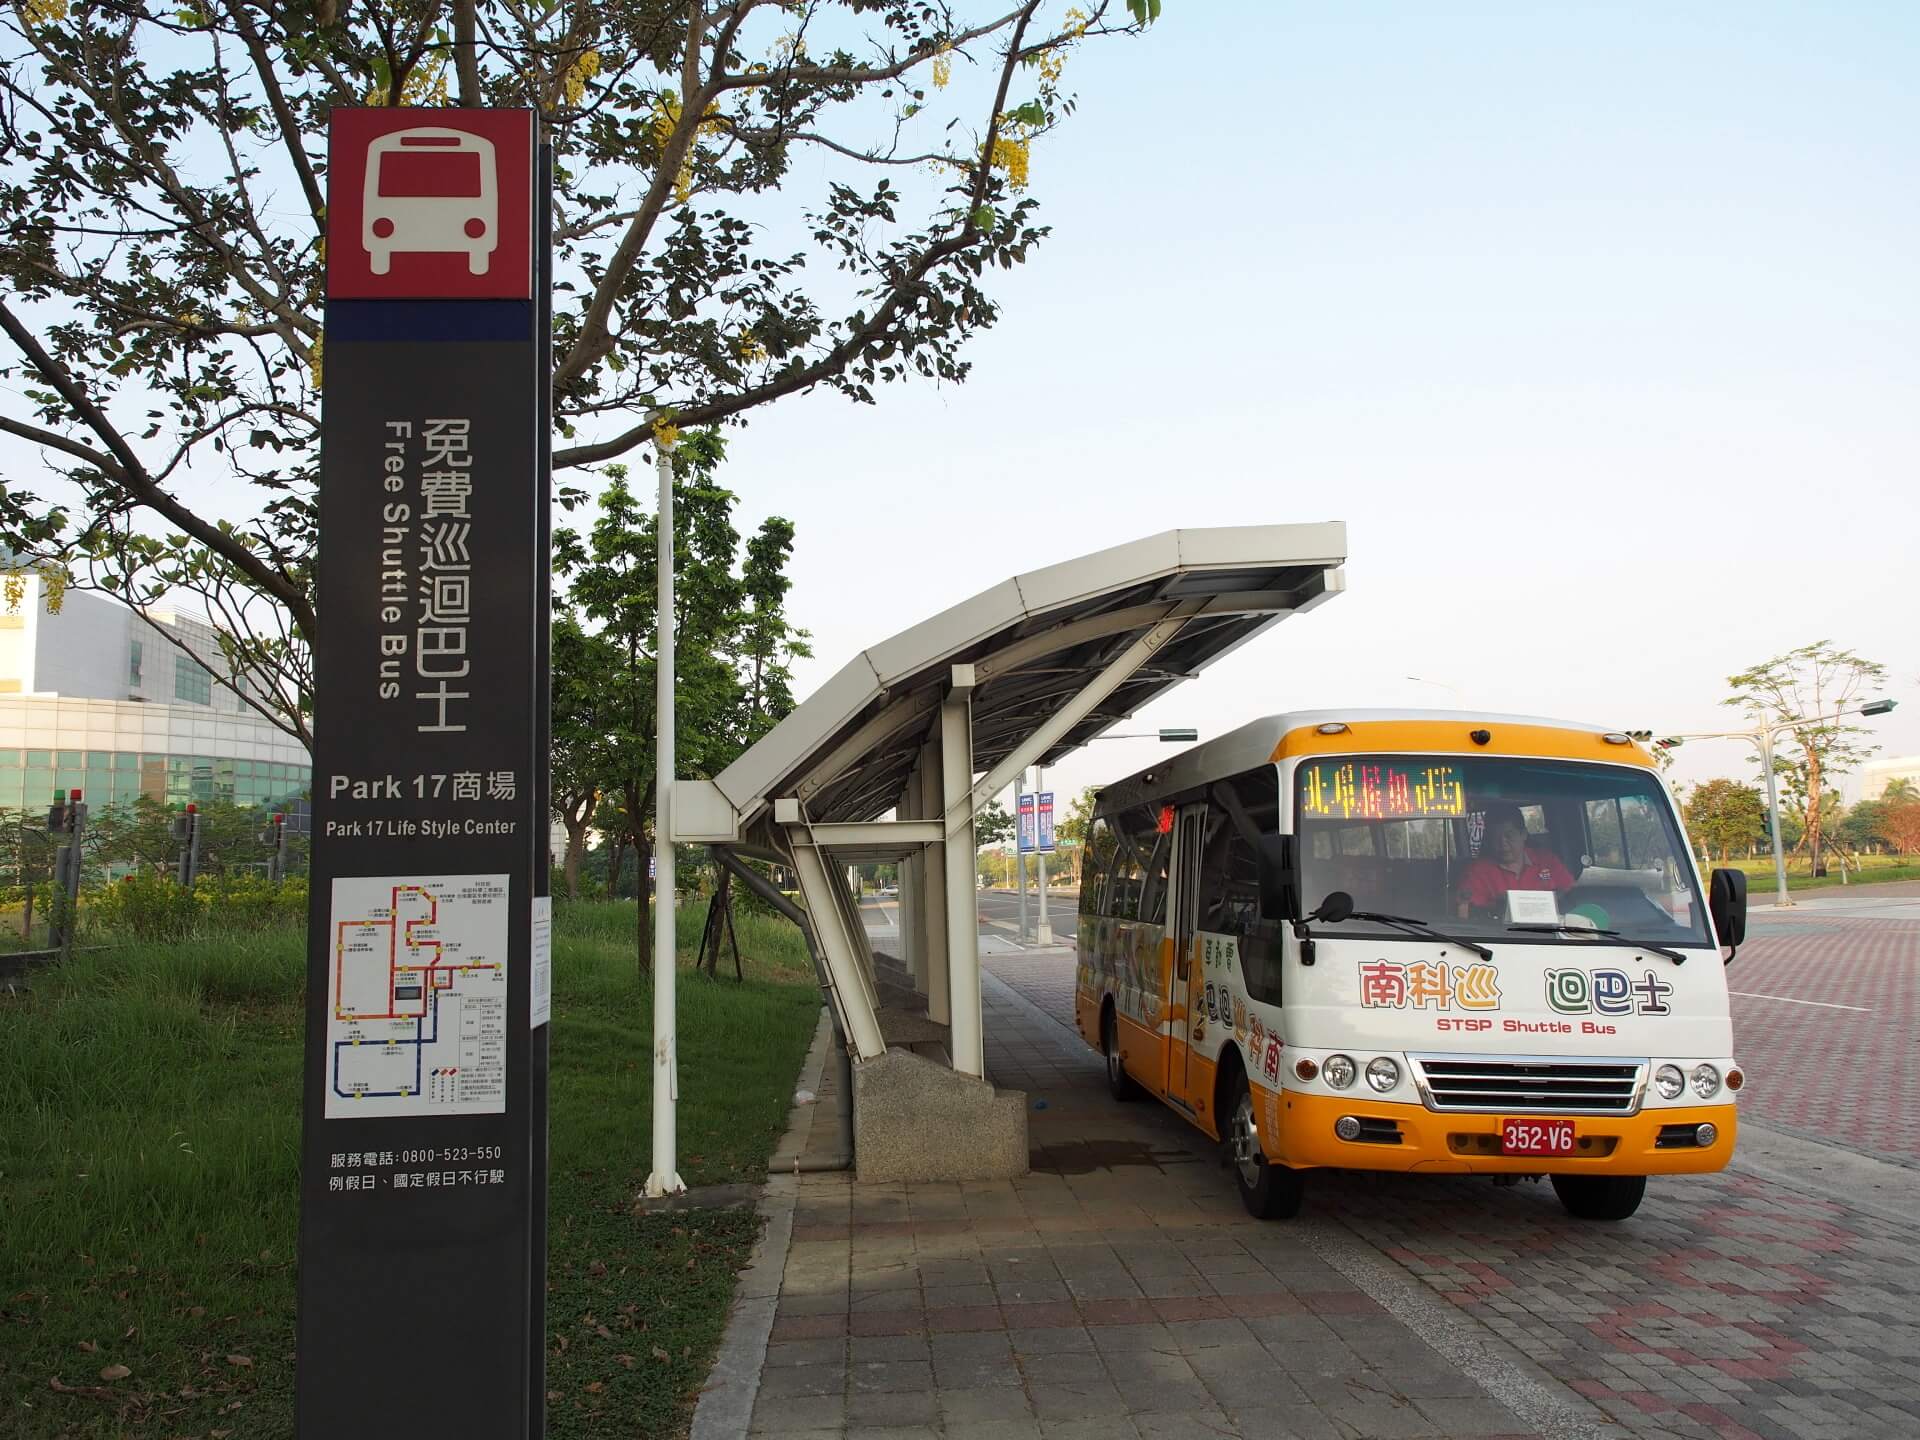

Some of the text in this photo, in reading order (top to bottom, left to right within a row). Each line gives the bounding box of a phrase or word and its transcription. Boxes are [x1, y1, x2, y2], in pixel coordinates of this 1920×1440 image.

[379, 420, 411, 700] Free Shuttle Bus
[415, 417, 473, 733] 免費巡迴巴士
[330, 775, 402, 800] Park
[326, 819, 516, 839] Park 17 Life Style Center
[1358, 959, 1503, 1010] 南科巡
[1436, 1018, 1617, 1035] STSP Shuttle Bus
[1505, 1126, 1572, 1150] 352-V6
